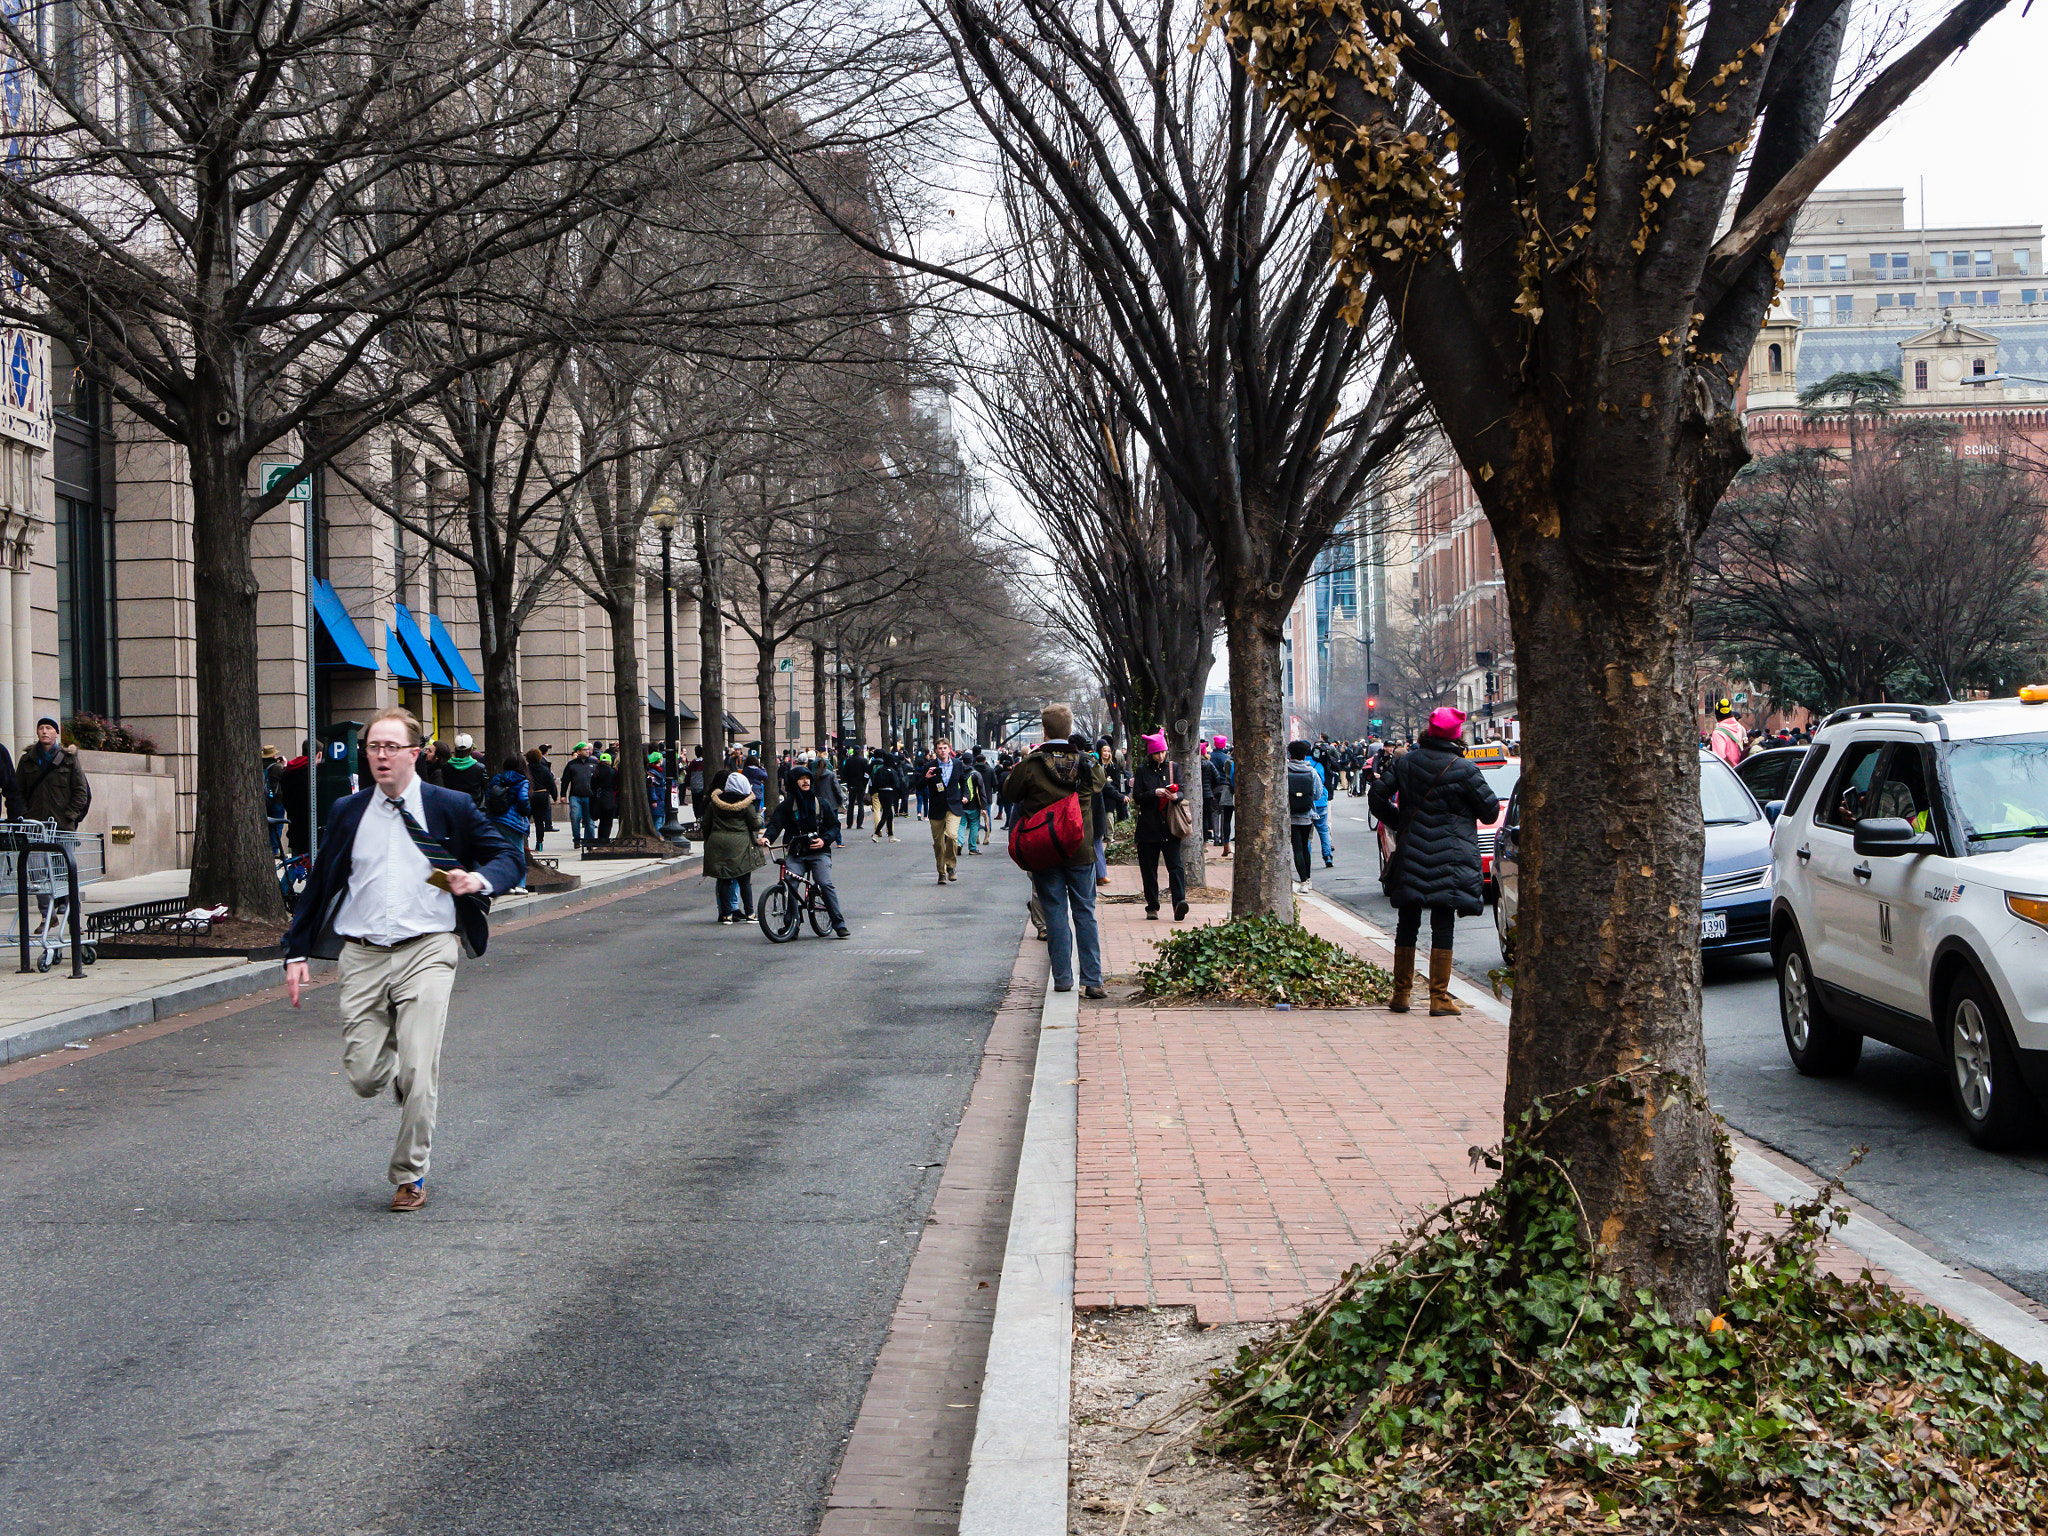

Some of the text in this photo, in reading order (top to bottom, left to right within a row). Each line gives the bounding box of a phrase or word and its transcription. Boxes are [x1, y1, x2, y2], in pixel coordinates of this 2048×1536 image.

[333, 741, 345, 759] P
[1475, 749, 1486, 758] FOR
[1487, 748, 1499, 757] HIRE
